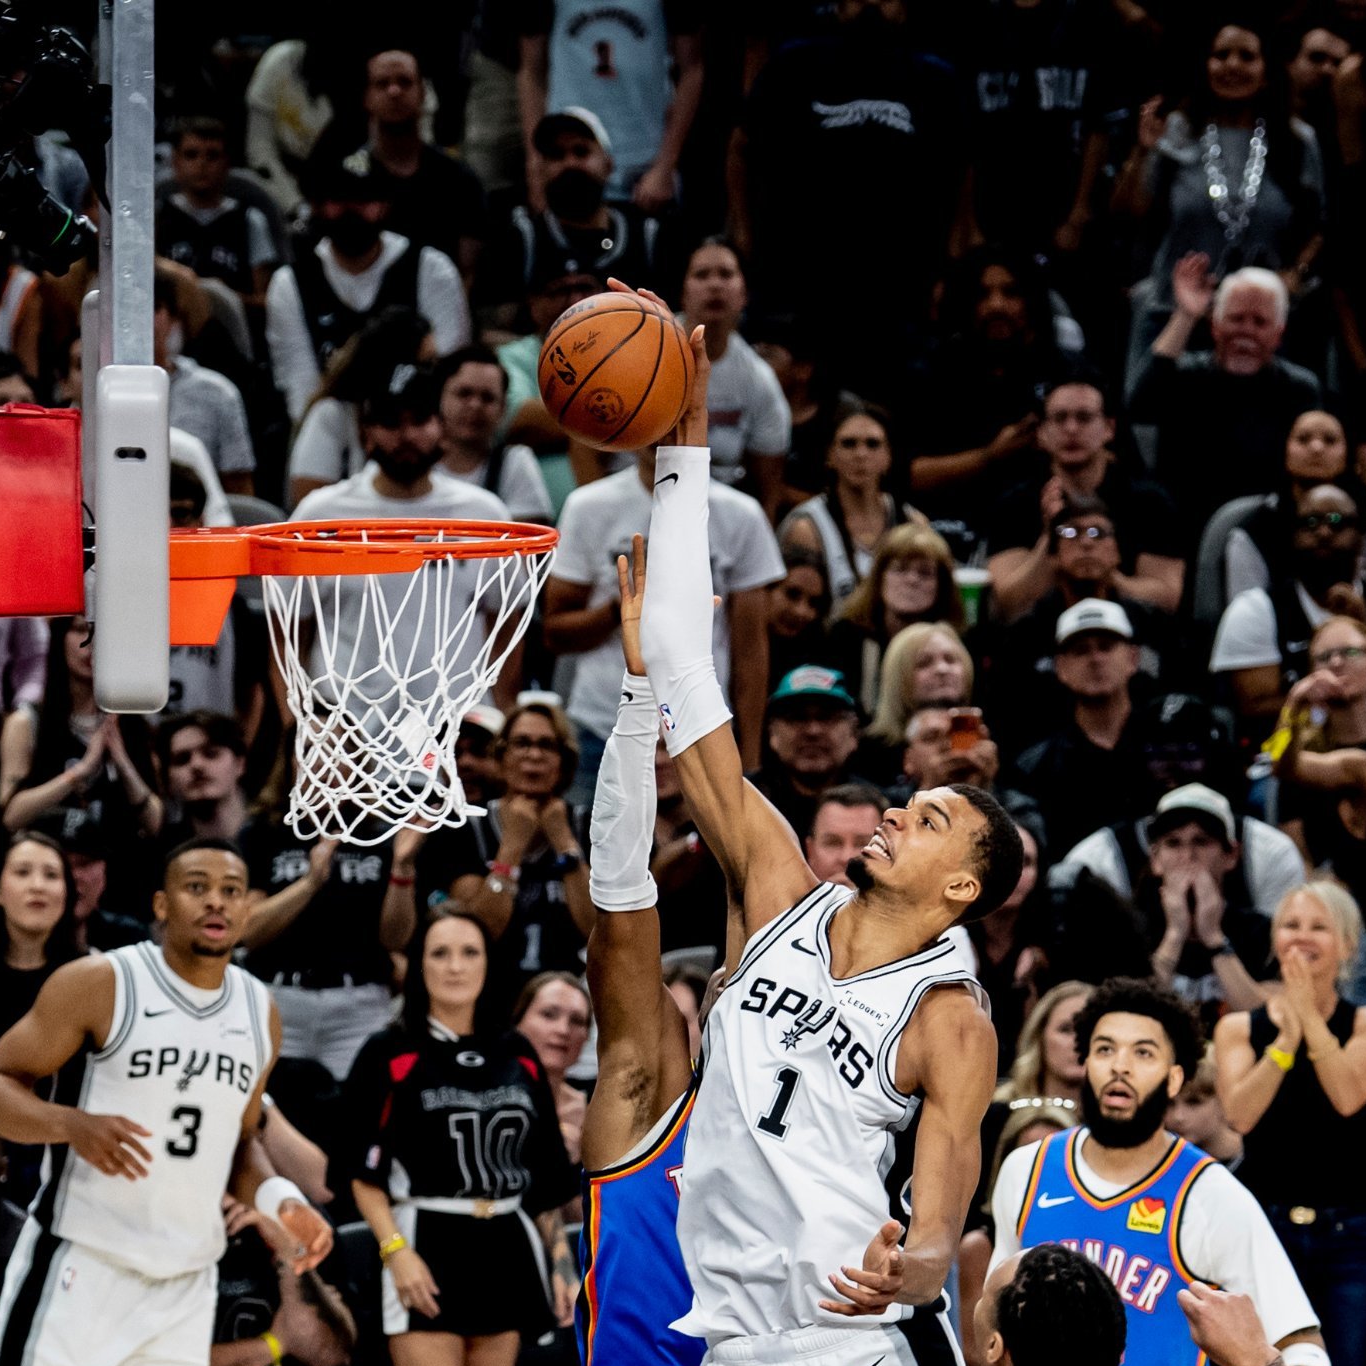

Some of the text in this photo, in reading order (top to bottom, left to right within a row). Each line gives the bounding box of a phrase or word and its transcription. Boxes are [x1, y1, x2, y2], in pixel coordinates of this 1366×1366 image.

[269, 852, 384, 886] SPRS
[740, 977, 874, 1090] SPURS
[847, 996, 883, 1021] LEDGER
[128, 1047, 253, 1094] SPURS
[755, 1065, 802, 1142] 1
[166, 1104, 202, 1158] 3
[447, 1110, 533, 1199] 10
